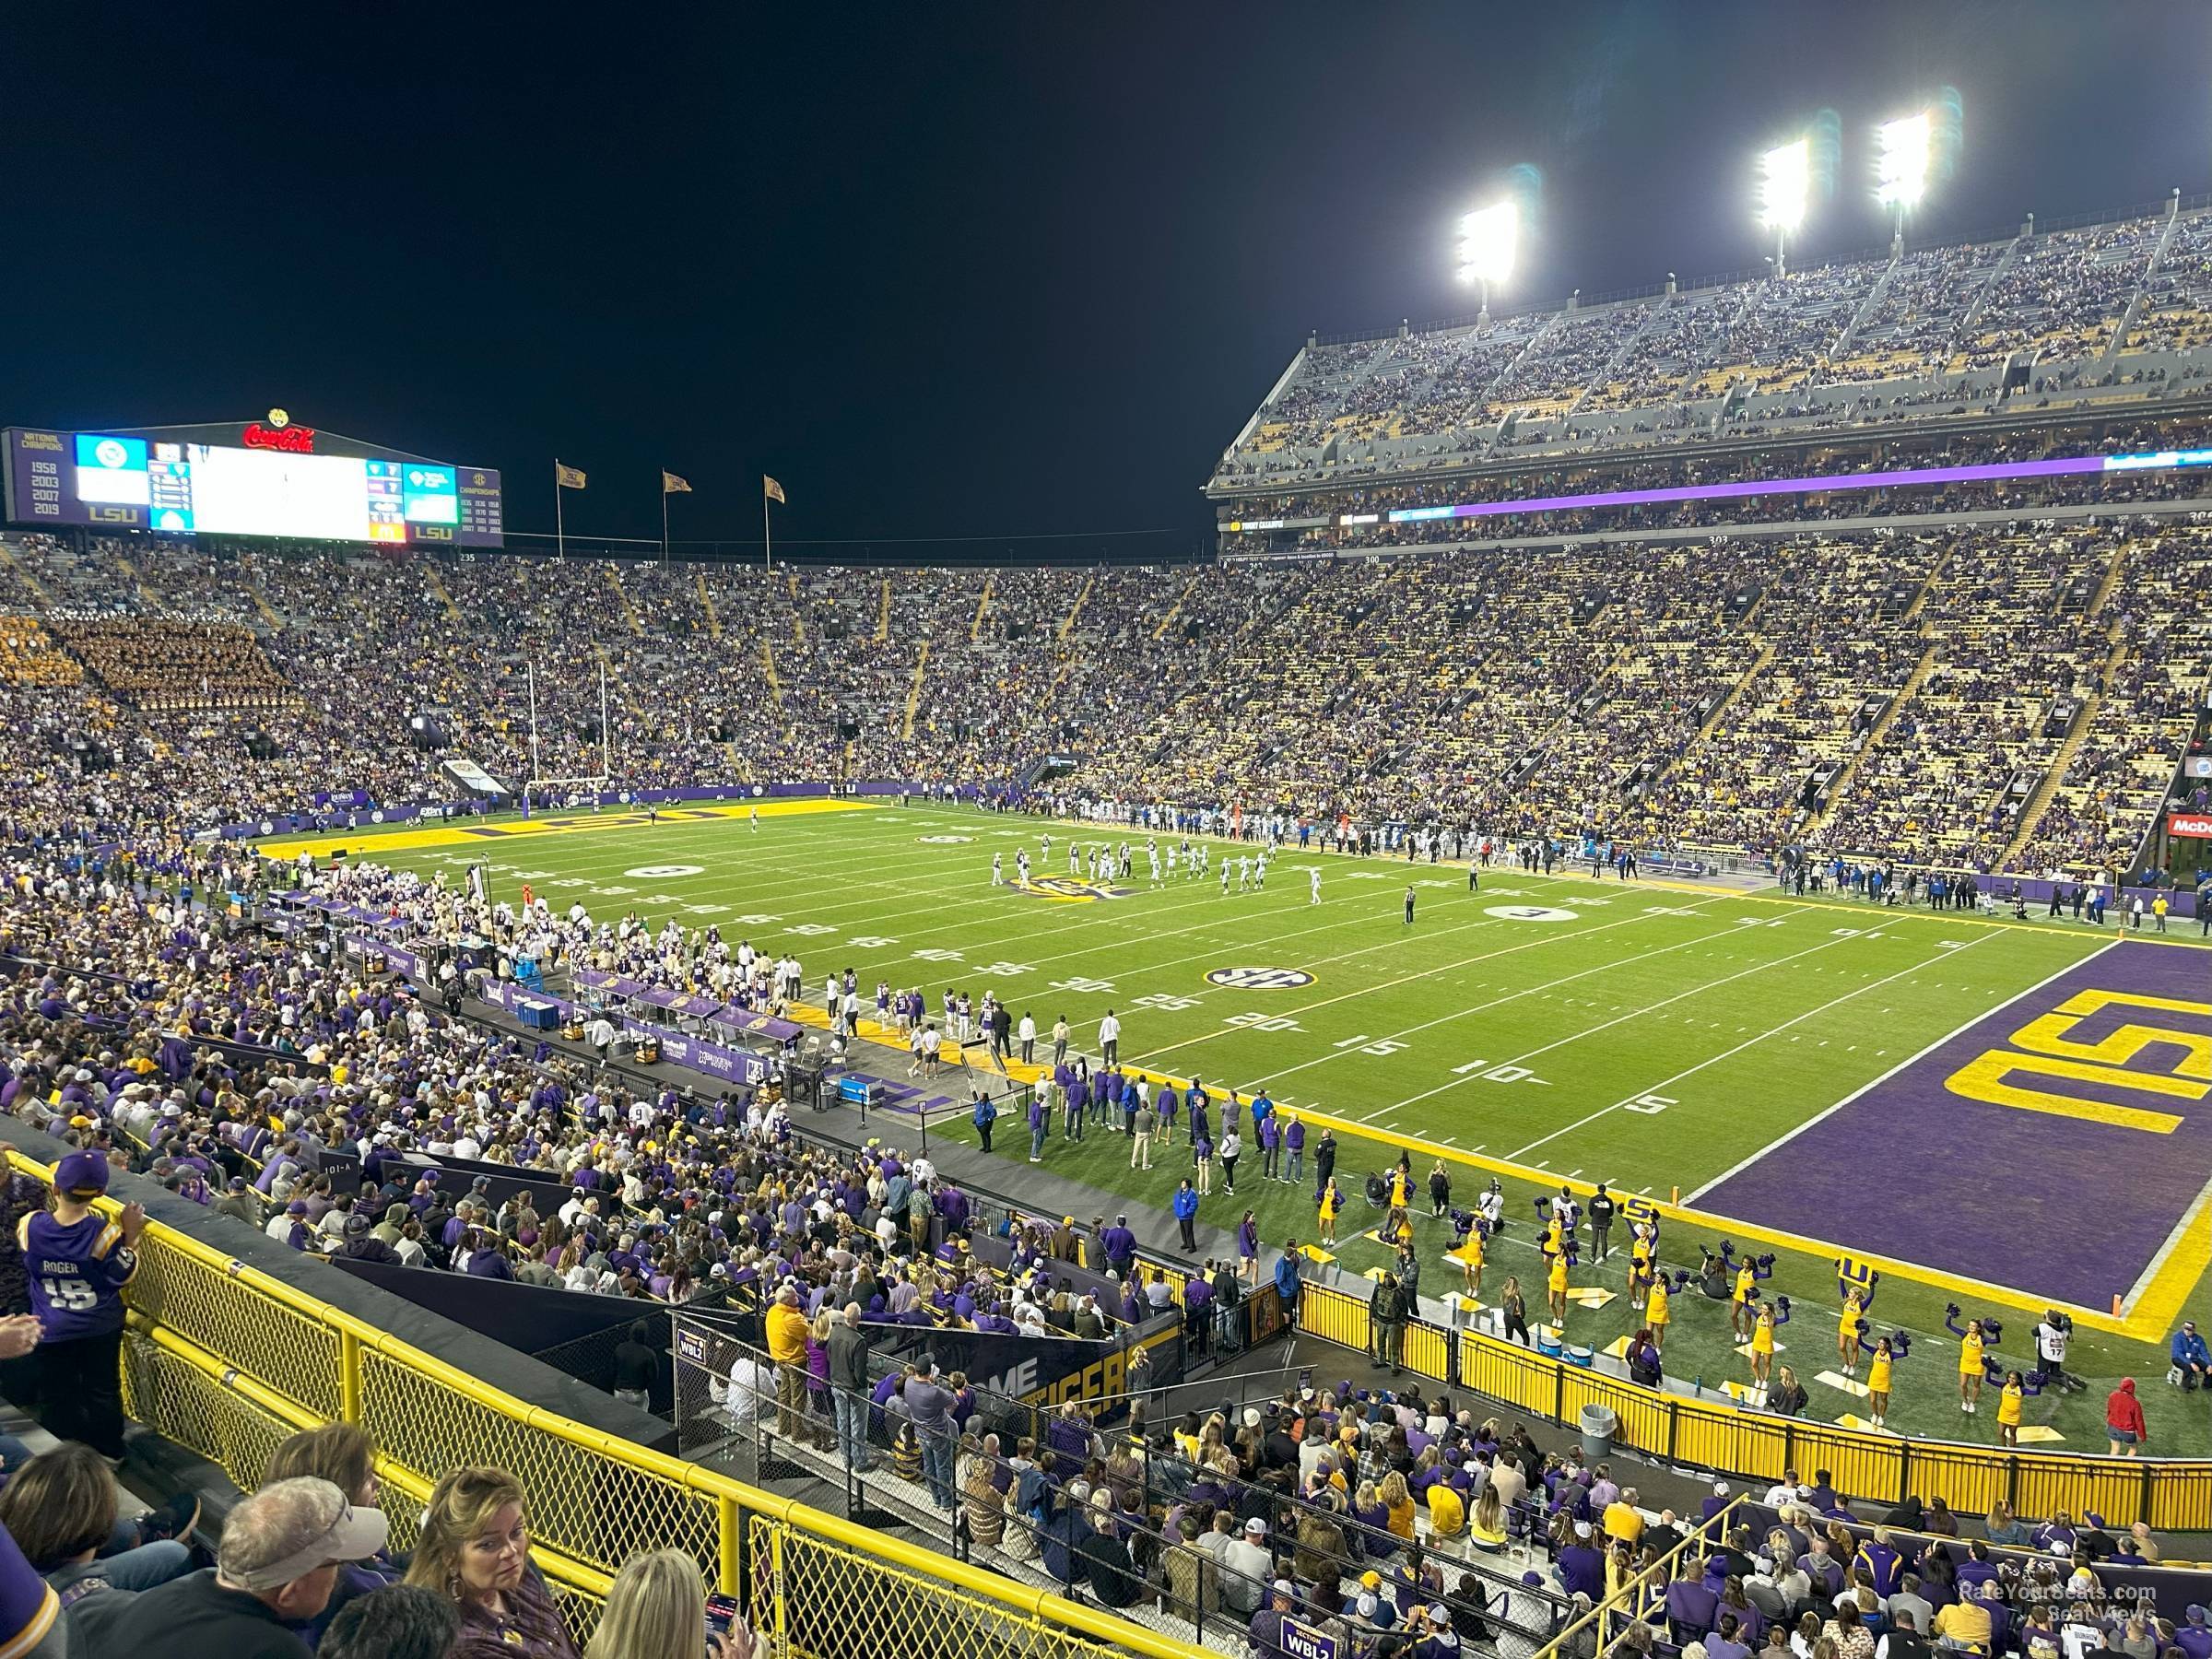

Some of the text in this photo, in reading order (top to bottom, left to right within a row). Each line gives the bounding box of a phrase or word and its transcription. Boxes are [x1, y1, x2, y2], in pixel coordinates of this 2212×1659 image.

[23, 432, 59, 442] NATIONAL
[243, 423, 314, 453] Coca-Cola
[21, 440, 64, 452] CHAMPIONS
[31, 462, 57, 474] 1958
[31, 476, 59, 488] 2003
[32, 489, 59, 501] 2007
[34, 503, 60, 515] 2019
[88, 506, 138, 524] LSU
[415, 525, 453, 541] LSU
[461, 554, 476, 562] 235
[643, 560, 658, 569] 237
[1365, 556, 1380, 564] 300
[830, 783, 856, 794] LU
[972, 961, 1038, 977] 35
[1047, 976, 1117, 993] 30
[1212, 968, 1308, 989] SEC
[1130, 993, 1205, 1011] 25
[1221, 1011, 1300, 1032] 20
[1333, 1034, 1411, 1056] 15
[1450, 1059, 1535, 1084] 10
[1624, 1094, 1680, 1115] 5
[324, 1162, 351, 1175] 101-A
[1627, 1198, 1652, 1218] S
[43, 1260, 79, 1275] ROGER
[1843, 1259, 1868, 1282] U
[679, 1339, 703, 1360] WBL2
[2049, 1347, 2062, 1358] 17
[1287, 1633, 1330, 1659] WBL2
[1295, 1629, 1321, 1647] SECTION
